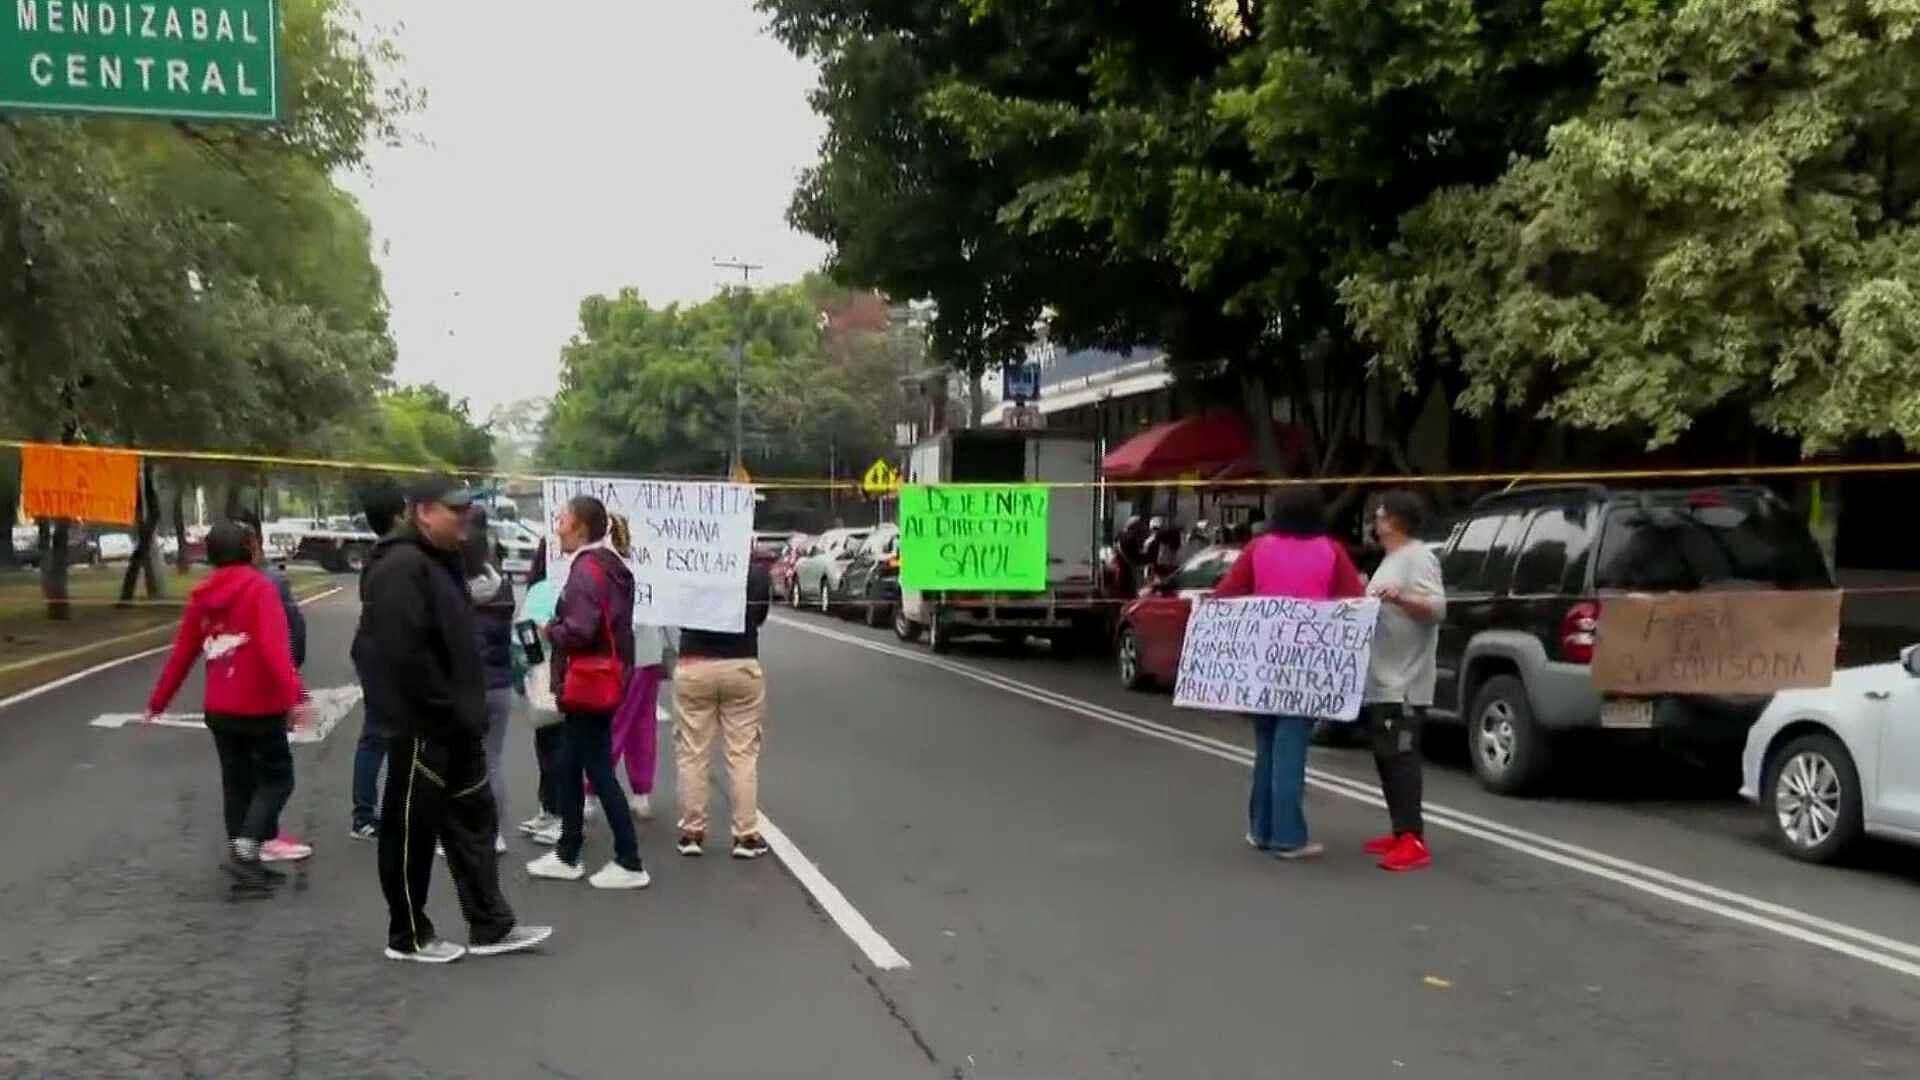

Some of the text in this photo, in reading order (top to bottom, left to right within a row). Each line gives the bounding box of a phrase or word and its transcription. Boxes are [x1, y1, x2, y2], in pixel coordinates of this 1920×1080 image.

[17, 0, 258, 43] MENDIZABAL
[30, 53, 258, 96] CENTRAL
[646, 517, 720, 542] SANTANA
[935, 515, 1029, 538] DIRECTOR
[665, 547, 737, 573] ESCOLAR
[1240, 598, 1318, 621] PADRES
[1330, 602, 1358, 622] DE
[1192, 619, 1260, 642] FAMILIA
[1294, 620, 1373, 651] ESCUELA
[1180, 656, 1248, 682] UNIDOS
[1256, 664, 1335, 692] CONTRA
[1265, 642, 1357, 677] QUINTANA
[1255, 685, 1345, 716] AUTORIDAD
